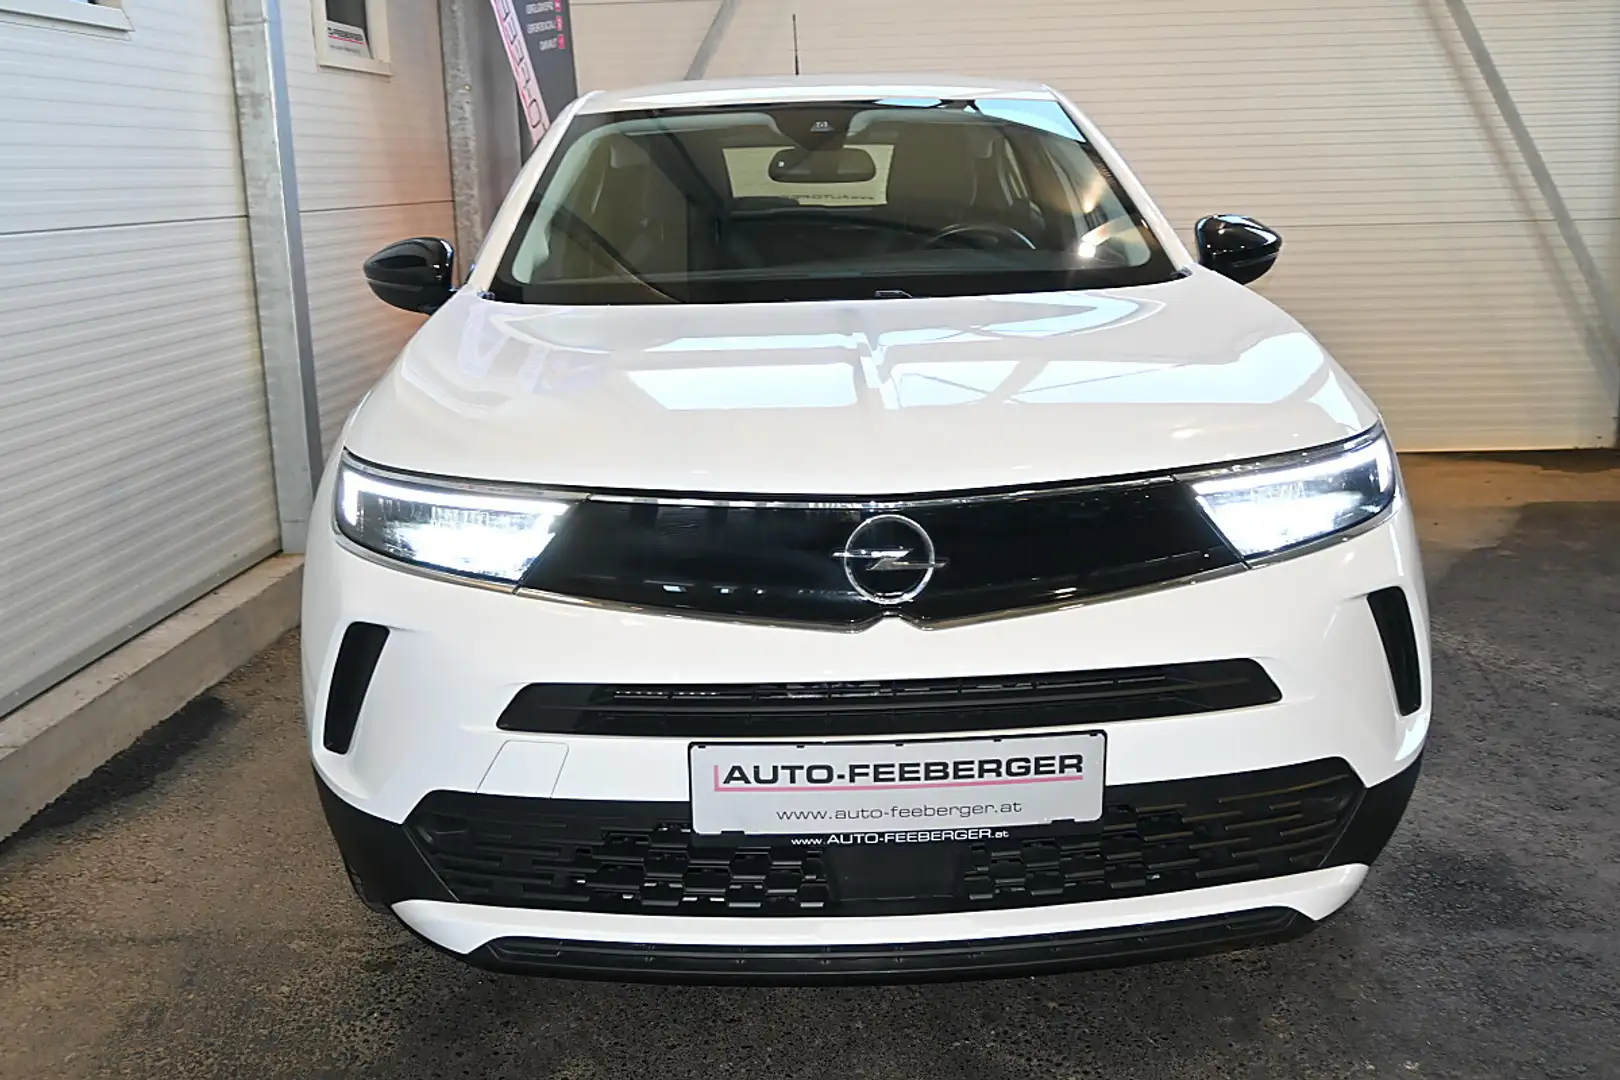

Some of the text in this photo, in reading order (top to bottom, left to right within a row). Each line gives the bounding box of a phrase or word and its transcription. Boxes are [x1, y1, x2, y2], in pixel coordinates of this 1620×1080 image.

[722, 754, 1083, 785] AUTO-FEEBERGER
[776, 802, 1023, 820] www.auto-feeberger.at
[791, 828, 1010, 845] www.AUTO-FEEBERGER.at
